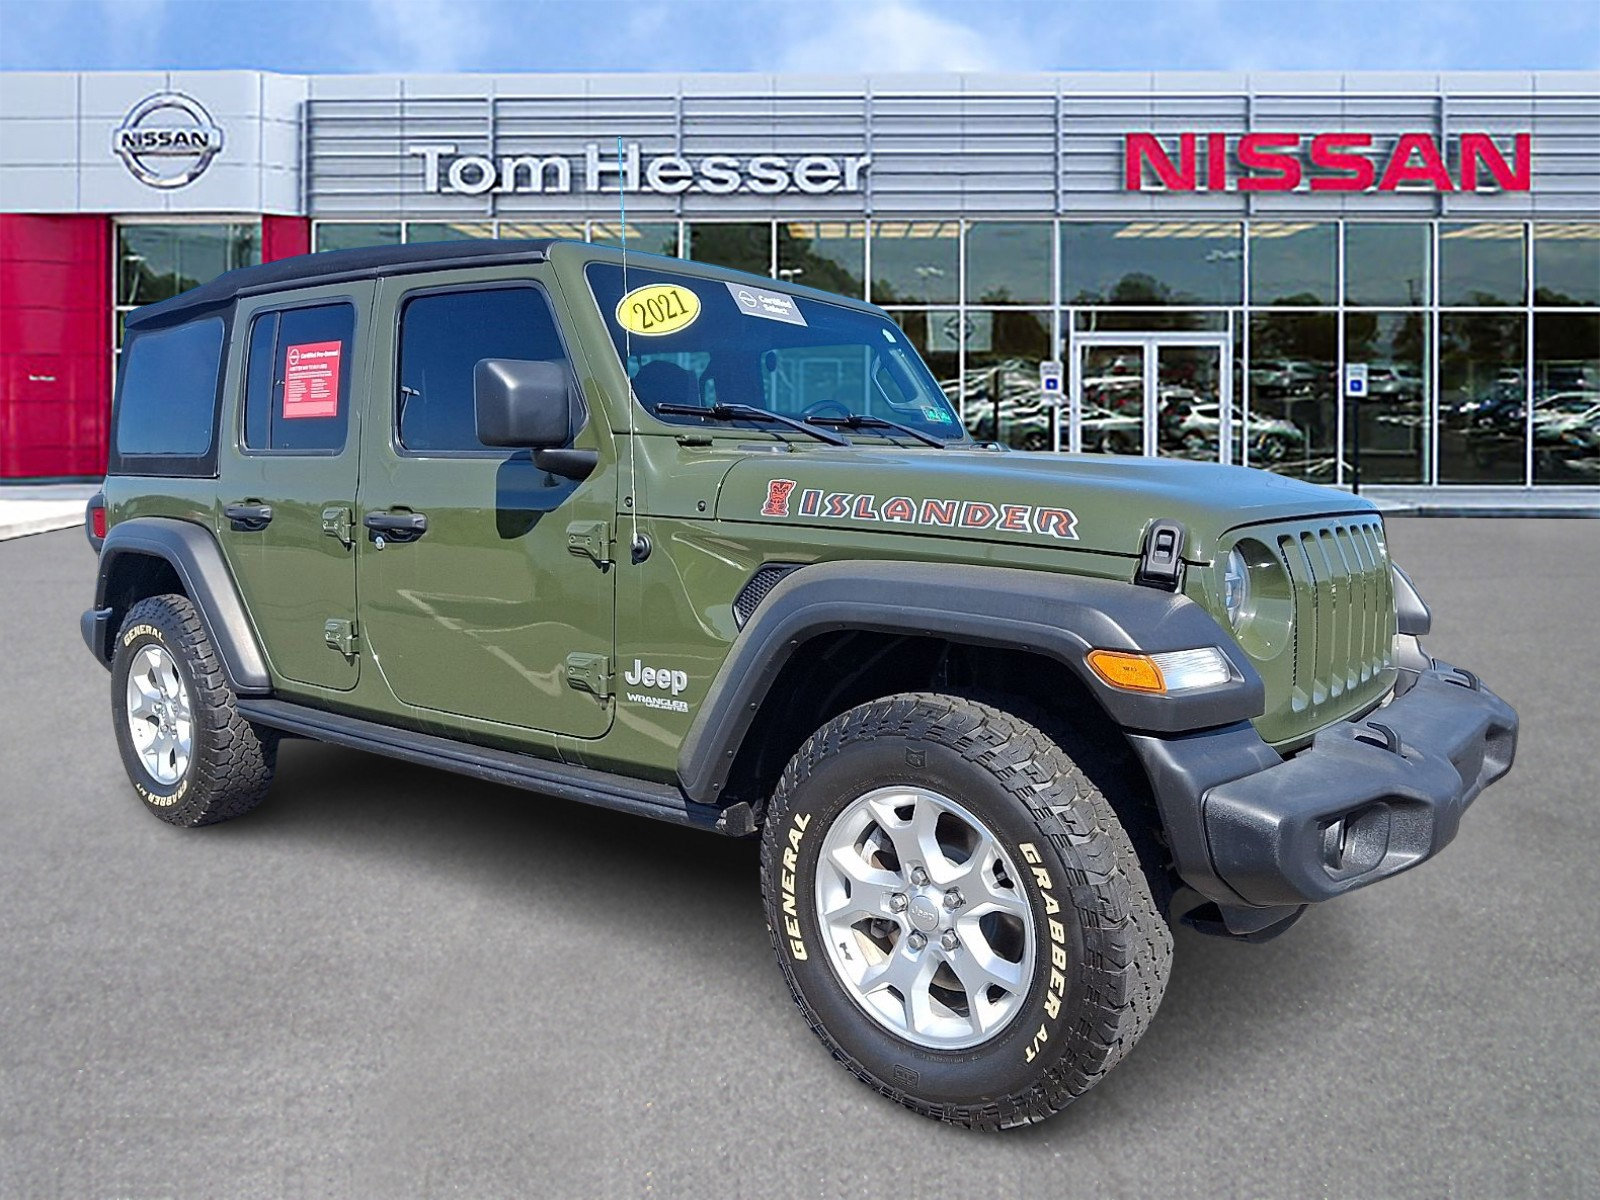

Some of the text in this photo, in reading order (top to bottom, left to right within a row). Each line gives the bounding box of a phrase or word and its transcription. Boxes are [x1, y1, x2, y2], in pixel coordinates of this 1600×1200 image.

[121, 131, 209, 147] NISSAN
[409, 143, 871, 194] Tom Hesser
[1125, 132, 1531, 191] NISSAN
[632, 290, 689, 329] 2021
[798, 488, 1080, 541] ISLANDER
[123, 624, 165, 647] GENERAL
[624, 658, 689, 696] Jeep
[626, 692, 689, 709] WRANGLER
[147, 779, 188, 807] GRABBER
[781, 813, 812, 961] GENERAL
[1018, 842, 1067, 1064] GRABBER A/T
